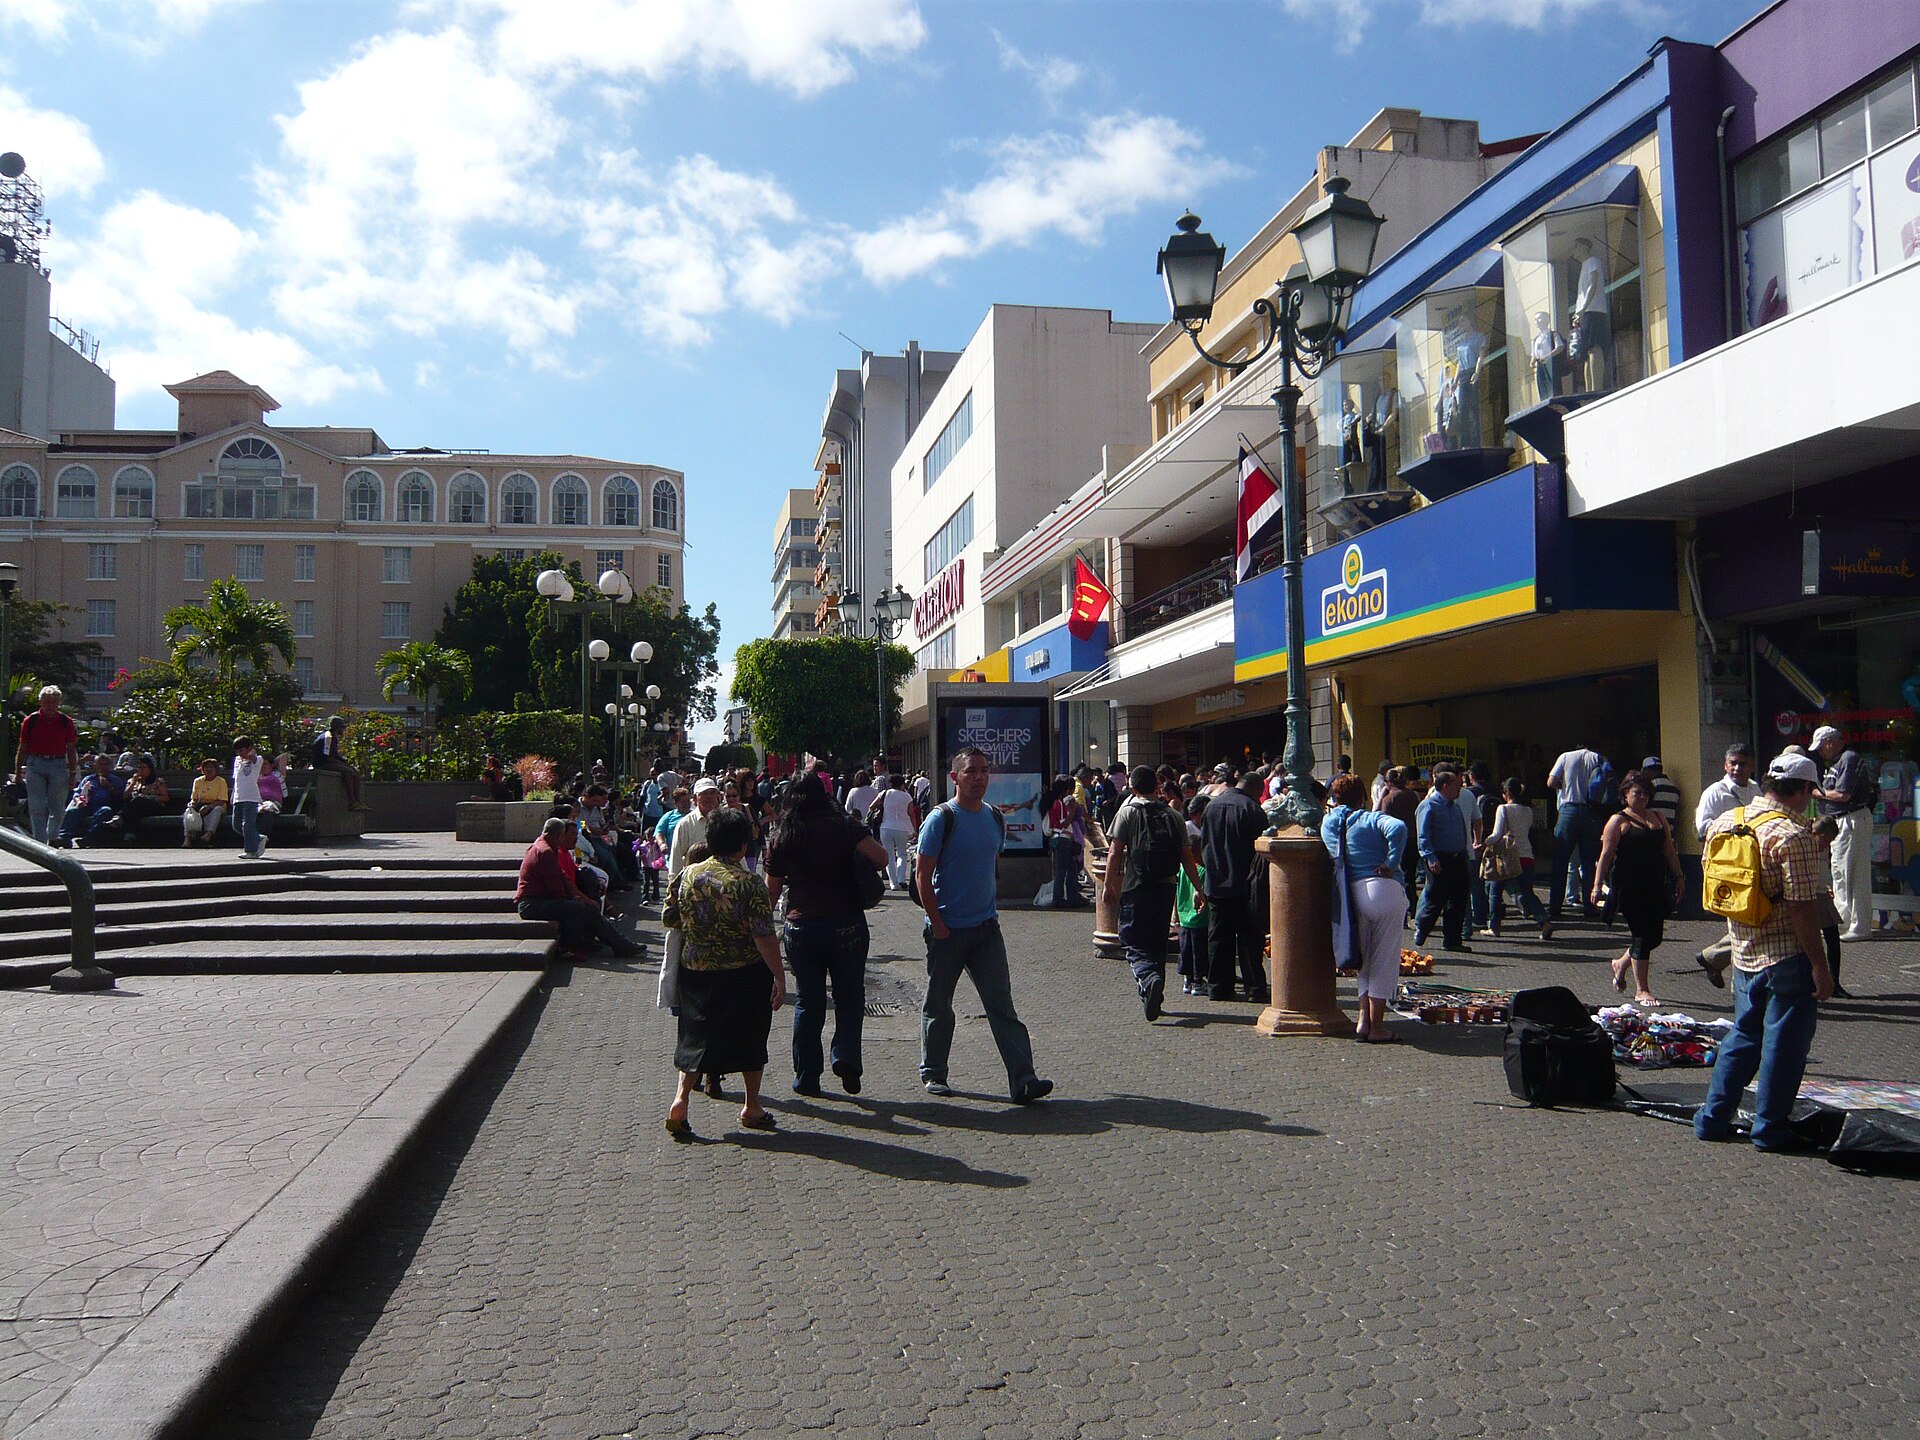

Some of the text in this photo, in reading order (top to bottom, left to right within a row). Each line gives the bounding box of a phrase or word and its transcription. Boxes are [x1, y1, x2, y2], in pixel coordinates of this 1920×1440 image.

[1798, 254, 1841, 284] Hallmark
[1830, 556, 1916, 582] Hallmark
[914, 559, 965, 639] CARRION
[1326, 588, 1382, 627] ekono
[958, 728, 1031, 746] SKECHERS
[1411, 743, 1435, 758] TODO
